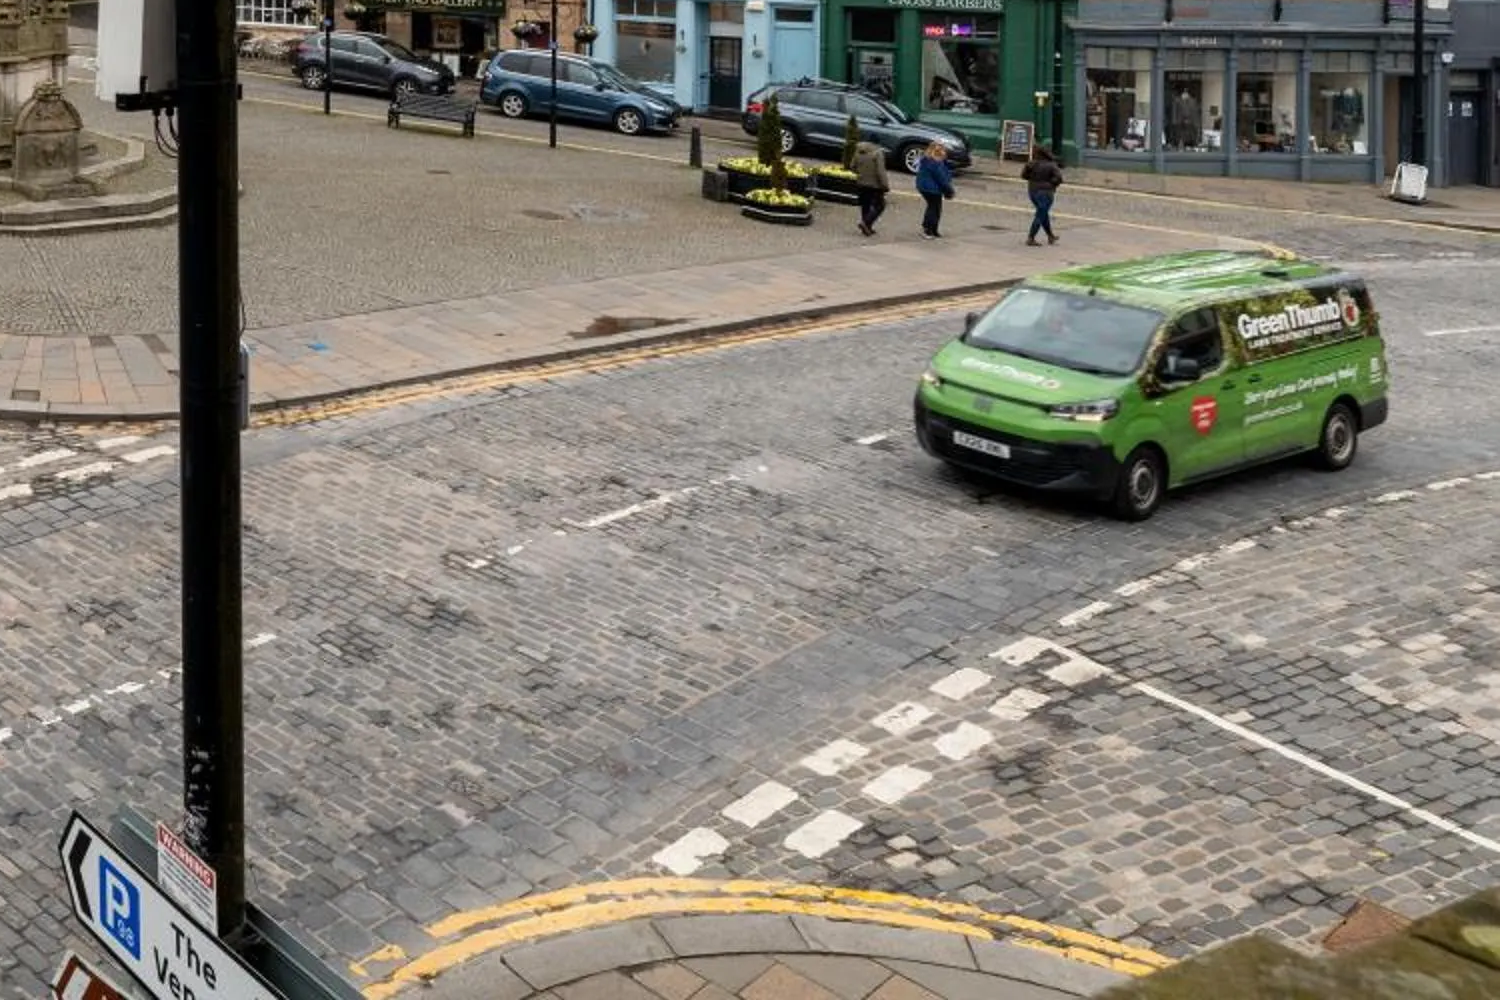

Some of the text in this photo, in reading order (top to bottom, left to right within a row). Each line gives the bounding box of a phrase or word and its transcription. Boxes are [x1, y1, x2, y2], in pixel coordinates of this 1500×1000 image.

[1237, 297, 1341, 339] GreenThumb
[161, 828, 214, 887] WARNING
[104, 866, 132, 929] P
[170, 921, 217, 990] The
